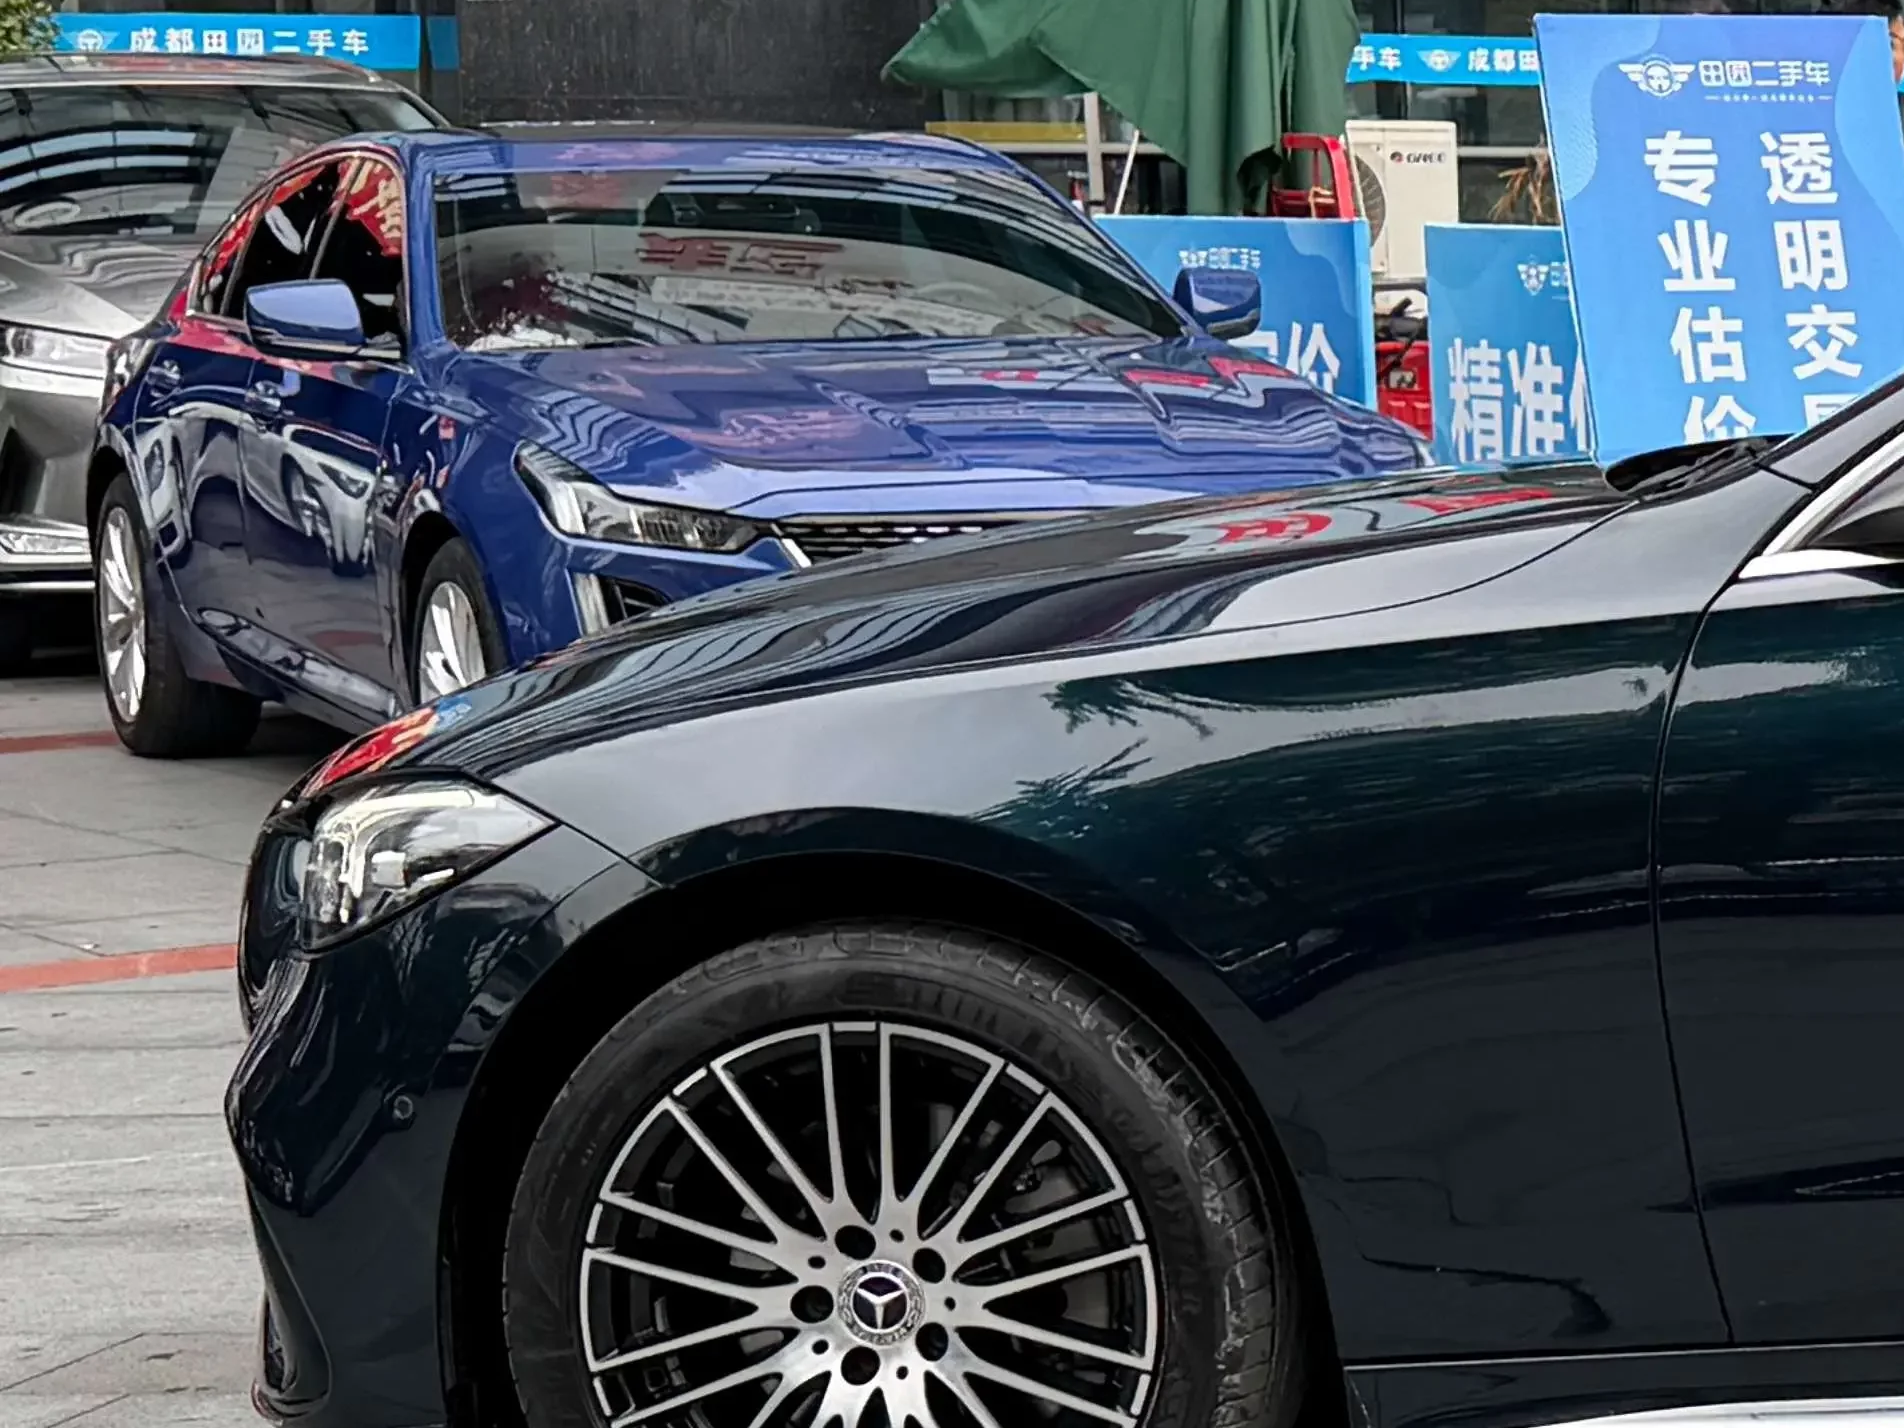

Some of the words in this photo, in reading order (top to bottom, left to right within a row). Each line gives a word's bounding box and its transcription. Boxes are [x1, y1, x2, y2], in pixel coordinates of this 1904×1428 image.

[130, 27, 370, 56] 成都田园二手车
[1699, 59, 1832, 88] 田园二手车
[1643, 129, 1757, 445] 专业估价
